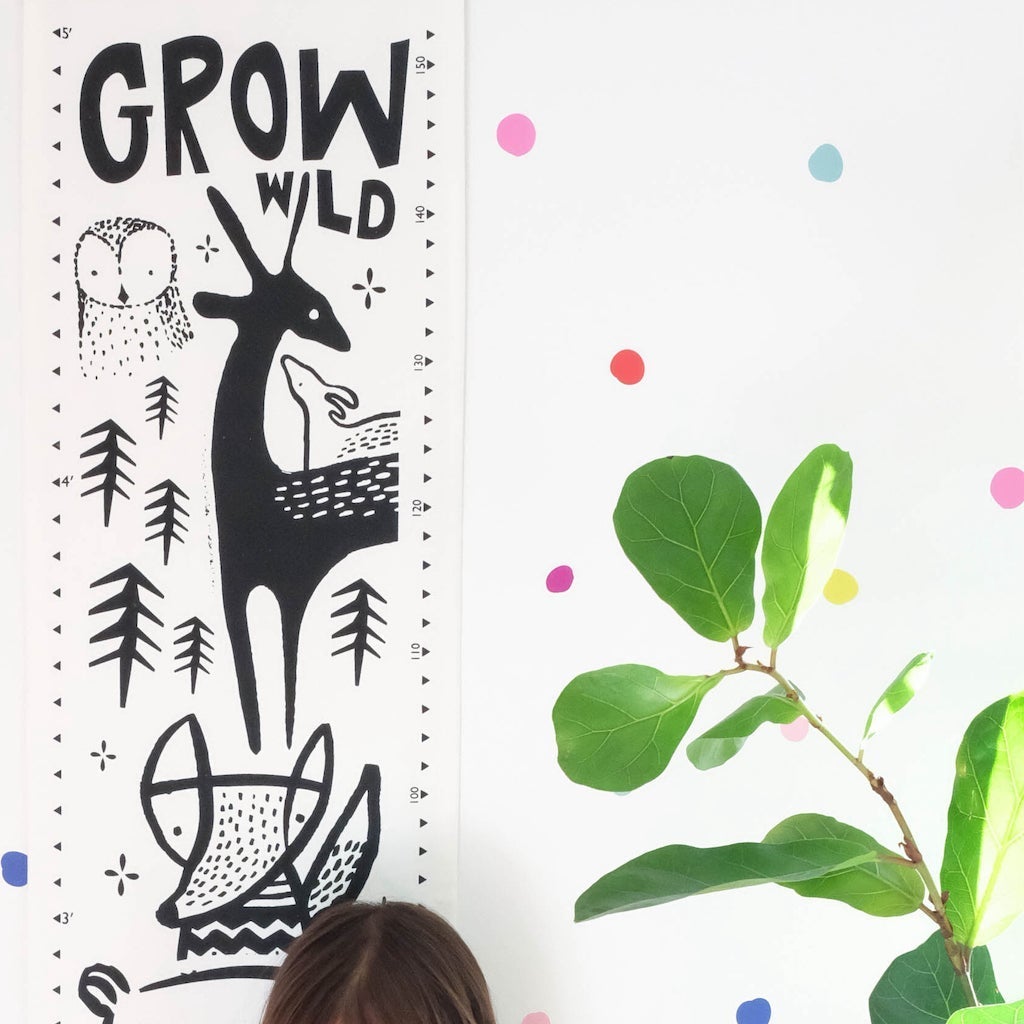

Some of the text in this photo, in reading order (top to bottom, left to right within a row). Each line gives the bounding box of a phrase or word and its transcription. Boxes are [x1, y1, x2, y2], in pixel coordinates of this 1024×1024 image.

[415, 55, 426, 75] 150
[79, 35, 410, 184] GROW
[415, 205, 425, 224] 140
[413, 354, 424, 372] 130
[412, 499, 422, 517] 120
[410, 643, 421, 660] 110
[409, 786, 419, 804] 100
